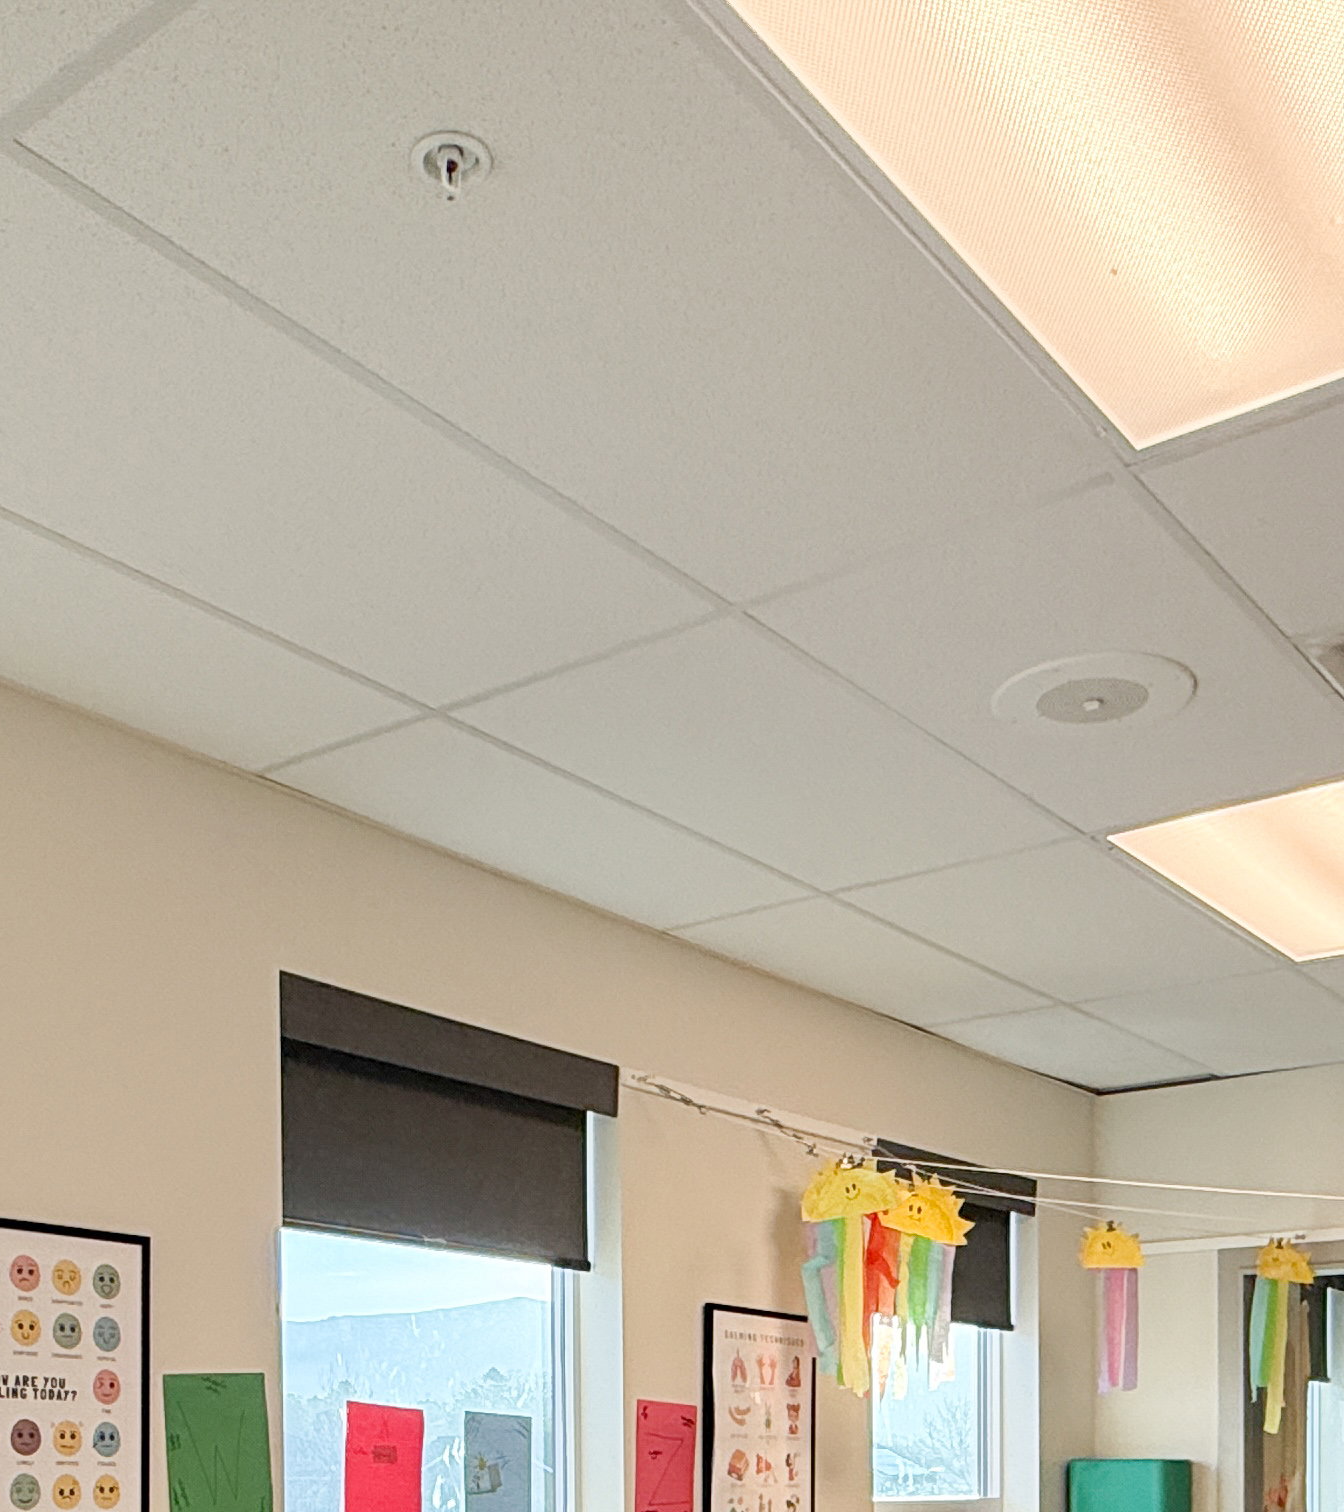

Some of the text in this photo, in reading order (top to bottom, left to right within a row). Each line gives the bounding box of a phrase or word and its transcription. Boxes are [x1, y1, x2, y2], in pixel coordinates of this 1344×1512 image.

[14, 1374, 38, 1388] ARE
[42, 1376, 67, 1389] YOU
[32, 1388, 78, 1402] TODAY?
